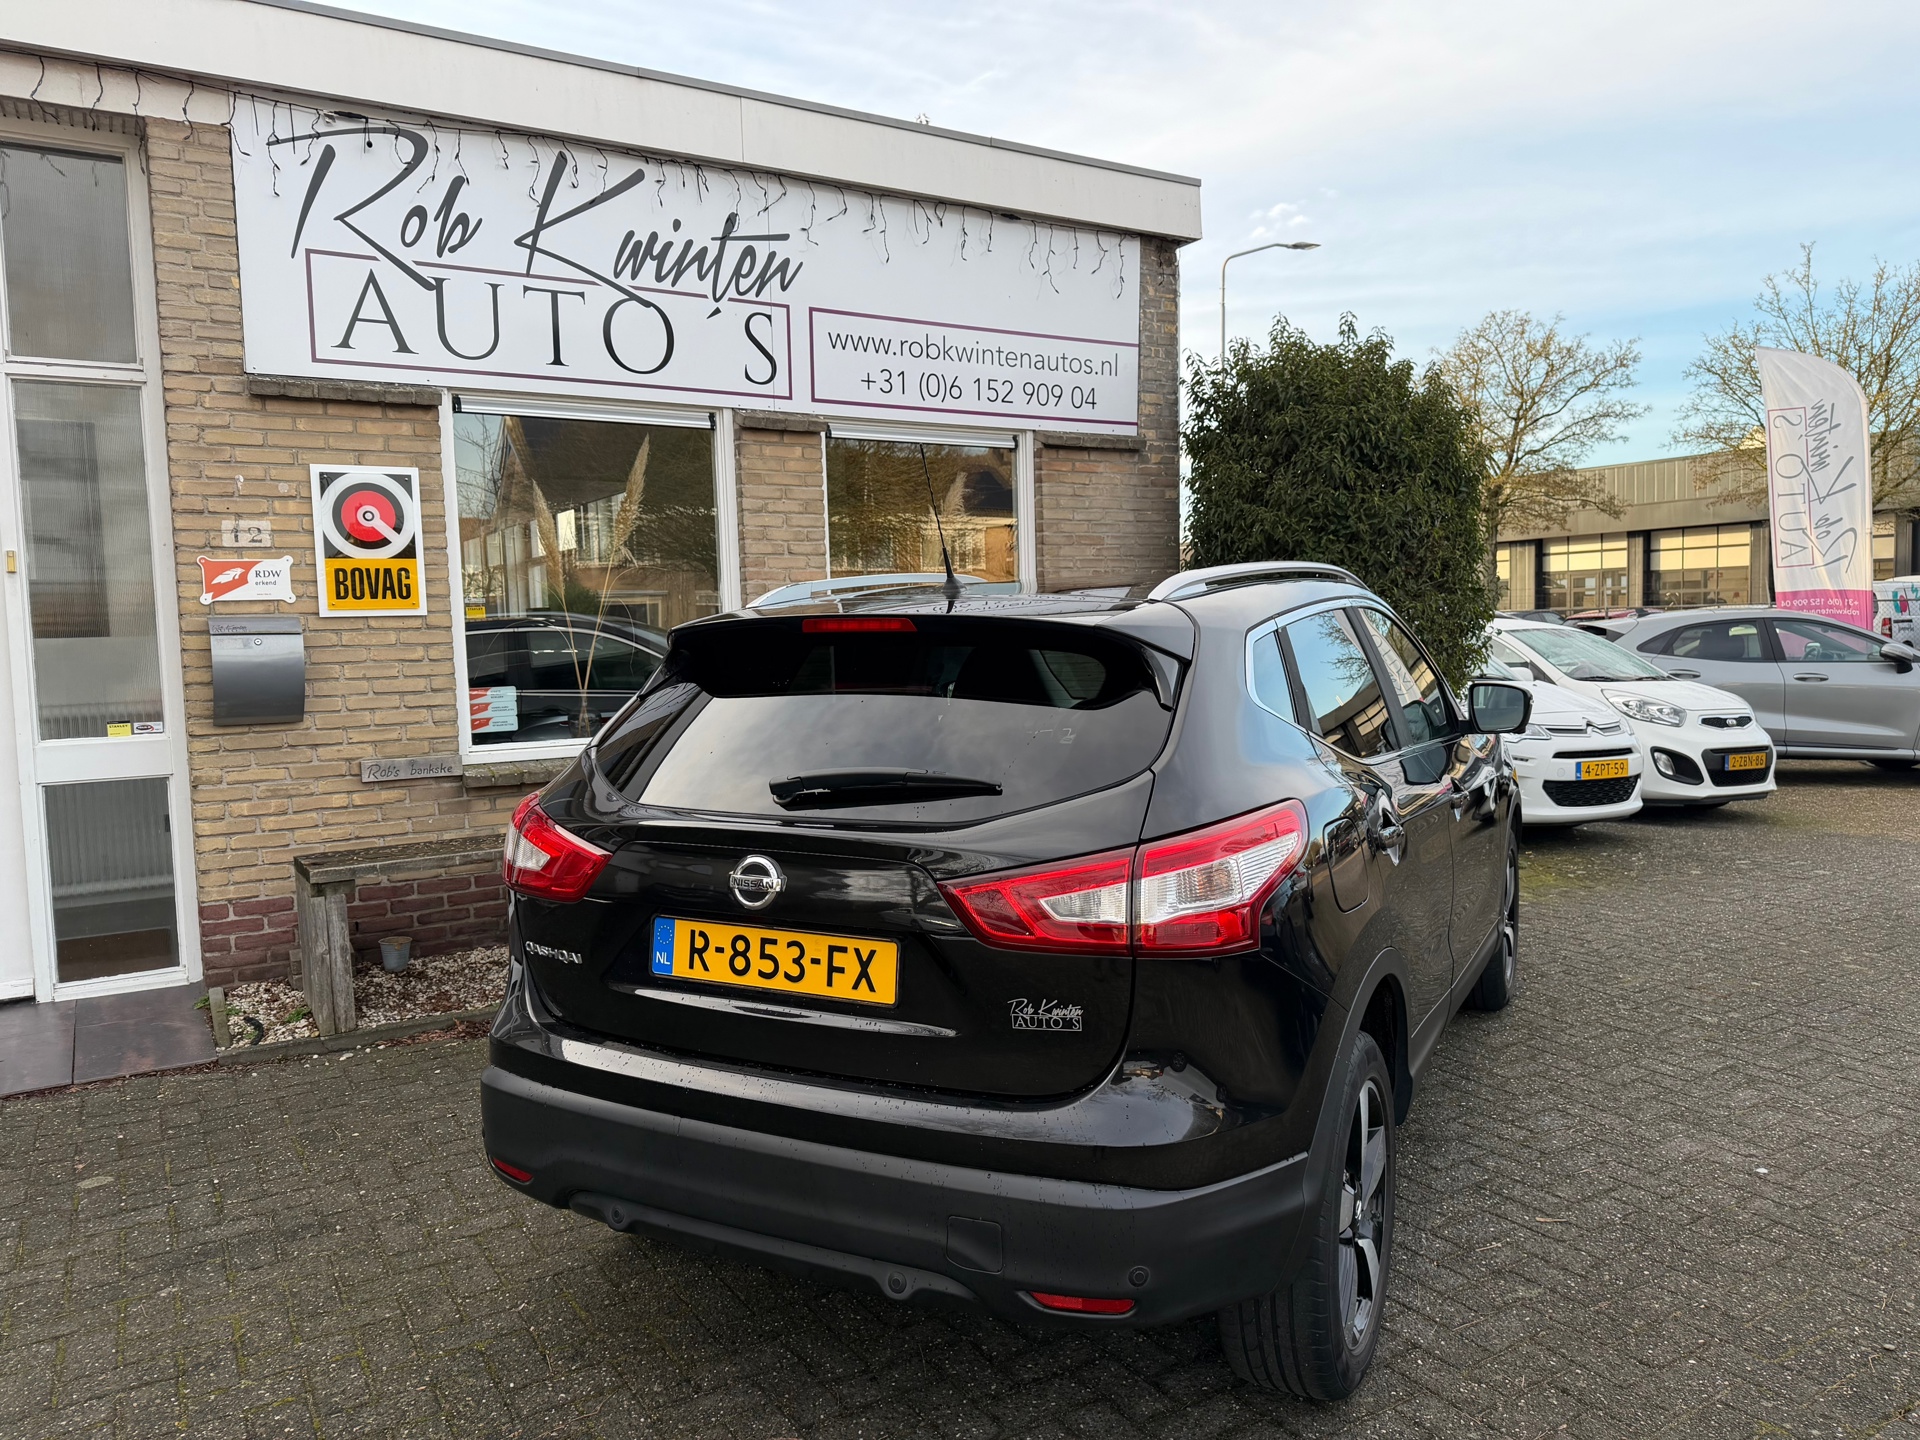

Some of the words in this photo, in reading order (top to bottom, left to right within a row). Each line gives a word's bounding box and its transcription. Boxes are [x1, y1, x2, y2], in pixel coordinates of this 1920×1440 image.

[266, 127, 483, 292] Rob
[514, 150, 803, 308] Kwinten
[828, 332, 1119, 377] www.robkwintenautos.nl
[861, 369, 905, 395] +31
[919, 372, 963, 403] (0)6
[973, 377, 1014, 404] 152
[1022, 382, 1063, 408] 909
[1070, 386, 1098, 410] 04
[255, 569, 282, 578] RDW
[334, 567, 412, 600] BOVAG
[367, 763, 400, 779] Rob's
[410, 763, 453, 776] bankske
[1585, 762, 1625, 777] 4-ZPT-59
[1731, 754, 1764, 768] 2-ZBN-86
[733, 876, 774, 889] NISSAN
[525, 941, 583, 964] QASHQAI
[655, 951, 671, 965] NL
[688, 928, 877, 993] R-853-FX
[1007, 998, 1035, 1019] Rob
